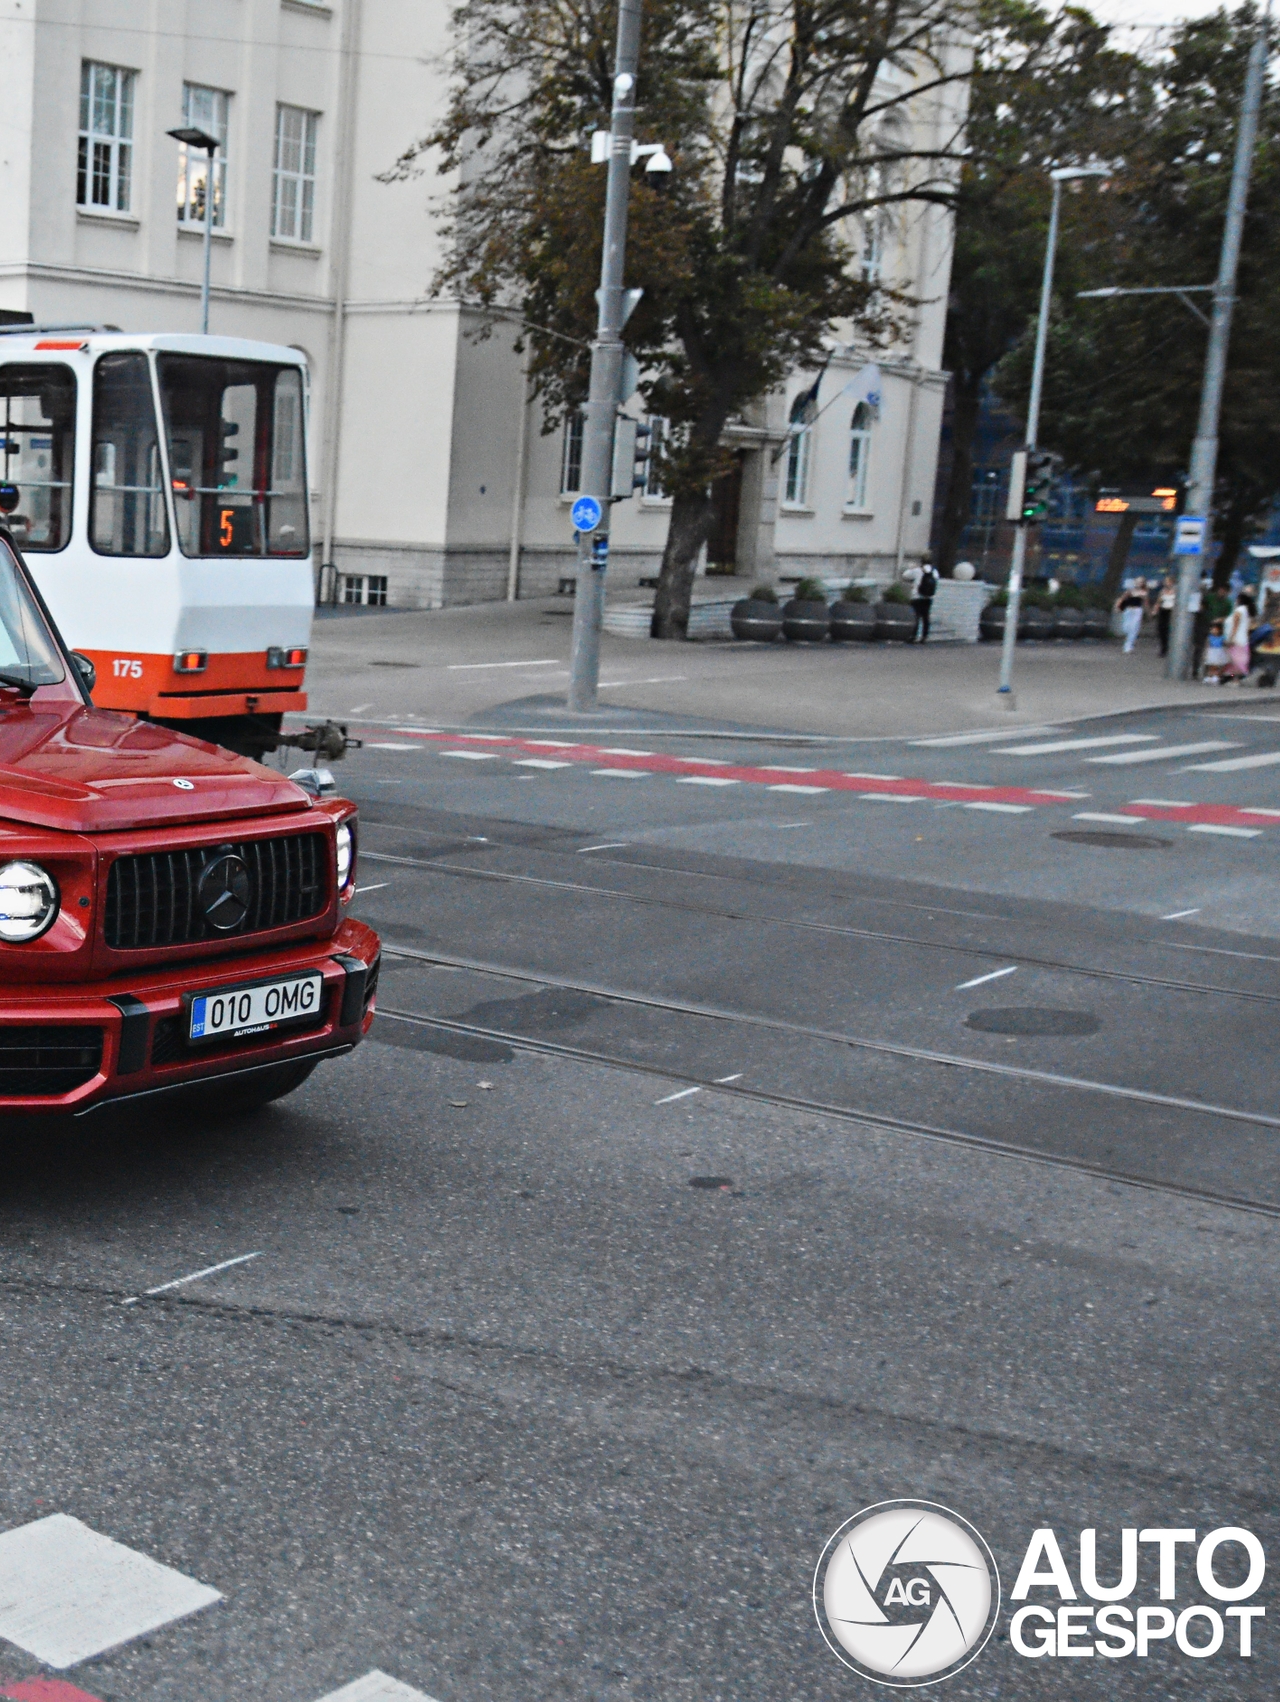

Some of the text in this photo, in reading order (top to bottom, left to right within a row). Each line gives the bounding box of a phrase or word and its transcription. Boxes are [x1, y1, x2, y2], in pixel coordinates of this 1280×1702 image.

[219, 509, 235, 547] 5
[112, 659, 143, 679] 175
[211, 981, 315, 1028] 010 OMG
[192, 1022, 206, 1034] EST
